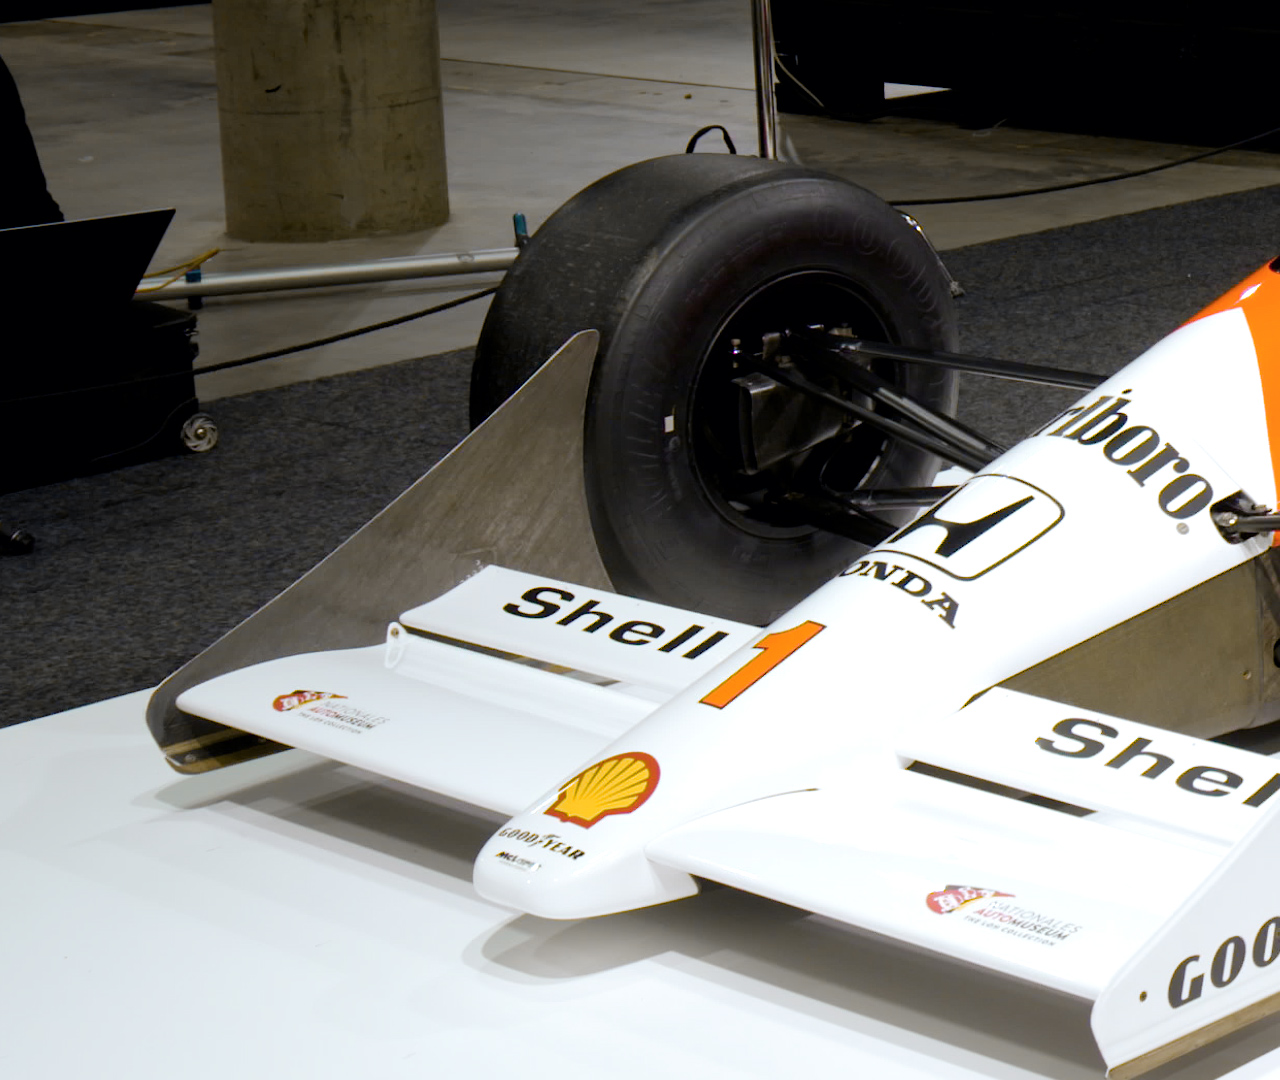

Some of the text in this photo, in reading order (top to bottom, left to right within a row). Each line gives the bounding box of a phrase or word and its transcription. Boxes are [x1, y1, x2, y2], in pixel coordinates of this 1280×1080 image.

[502, 585, 730, 661] Shell
[699, 620, 827, 710] 1
[498, 827, 585, 860] GOODYEAR
[973, 908, 1070, 941] AUTOMUSEUM
[989, 900, 1083, 935] NATIONALES
